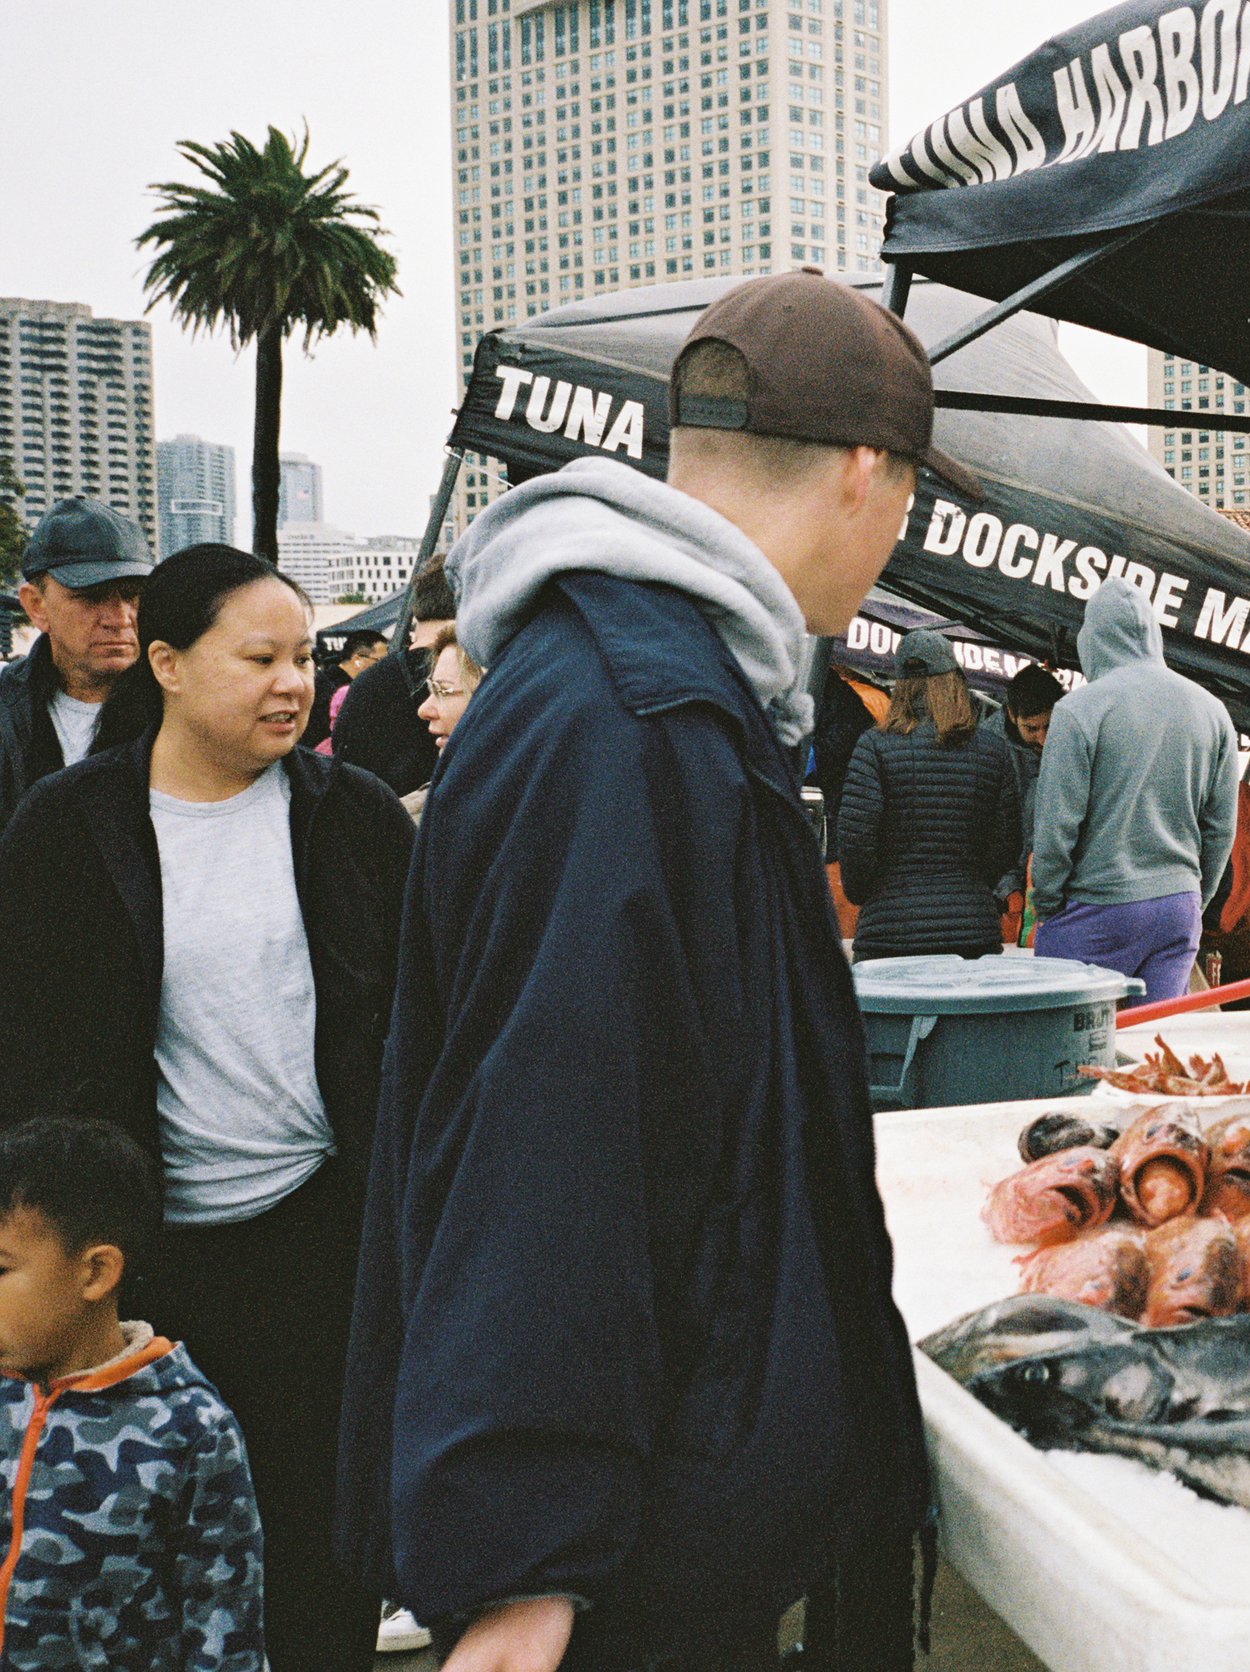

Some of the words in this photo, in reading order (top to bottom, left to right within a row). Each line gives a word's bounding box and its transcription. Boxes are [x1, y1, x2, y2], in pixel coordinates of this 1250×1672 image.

[880, 82, 1047, 189] TUNA
[495, 365, 645, 460] TUNA
[323, 636, 348, 651] TU
[847, 616, 1003, 676] DOIDE
